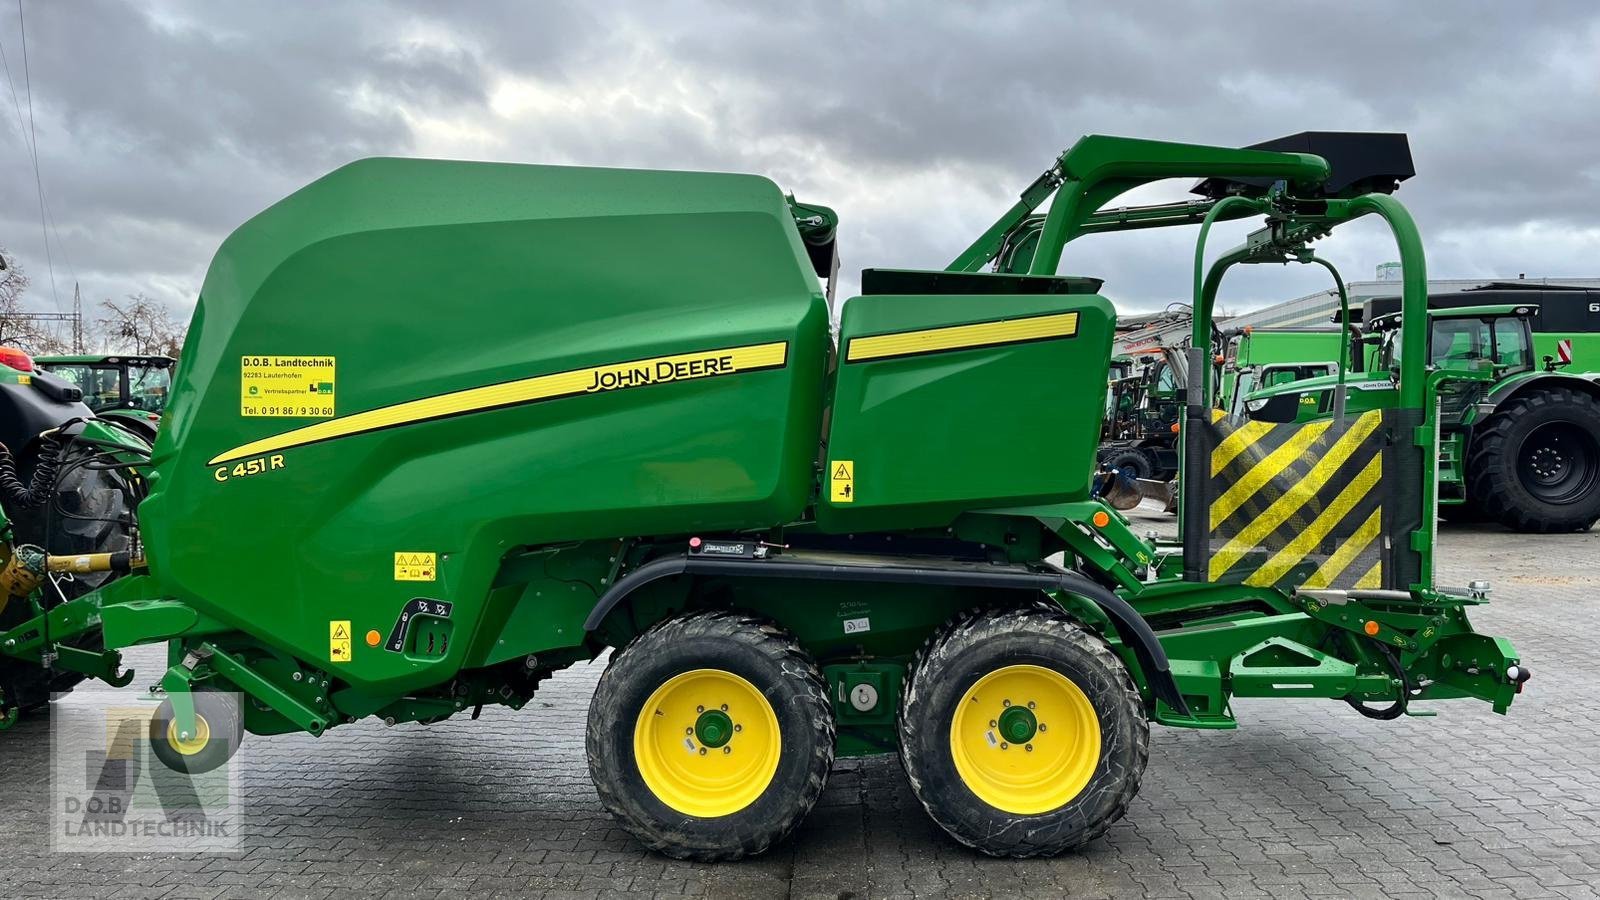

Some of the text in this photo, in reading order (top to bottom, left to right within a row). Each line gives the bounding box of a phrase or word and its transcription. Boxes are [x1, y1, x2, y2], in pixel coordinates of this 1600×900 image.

[243, 358, 333, 367] D.O.B. Landtechnik
[586, 356, 733, 390] JOHN DEERE
[243, 406, 259, 415] Tel.
[261, 406, 267, 415] 0
[269, 406, 279, 415] 91
[282, 406, 294, 415] 86
[301, 407, 307, 415] 9
[309, 407, 319, 415] 30
[322, 407, 333, 415] 60
[214, 454, 285, 482] C 451 R
